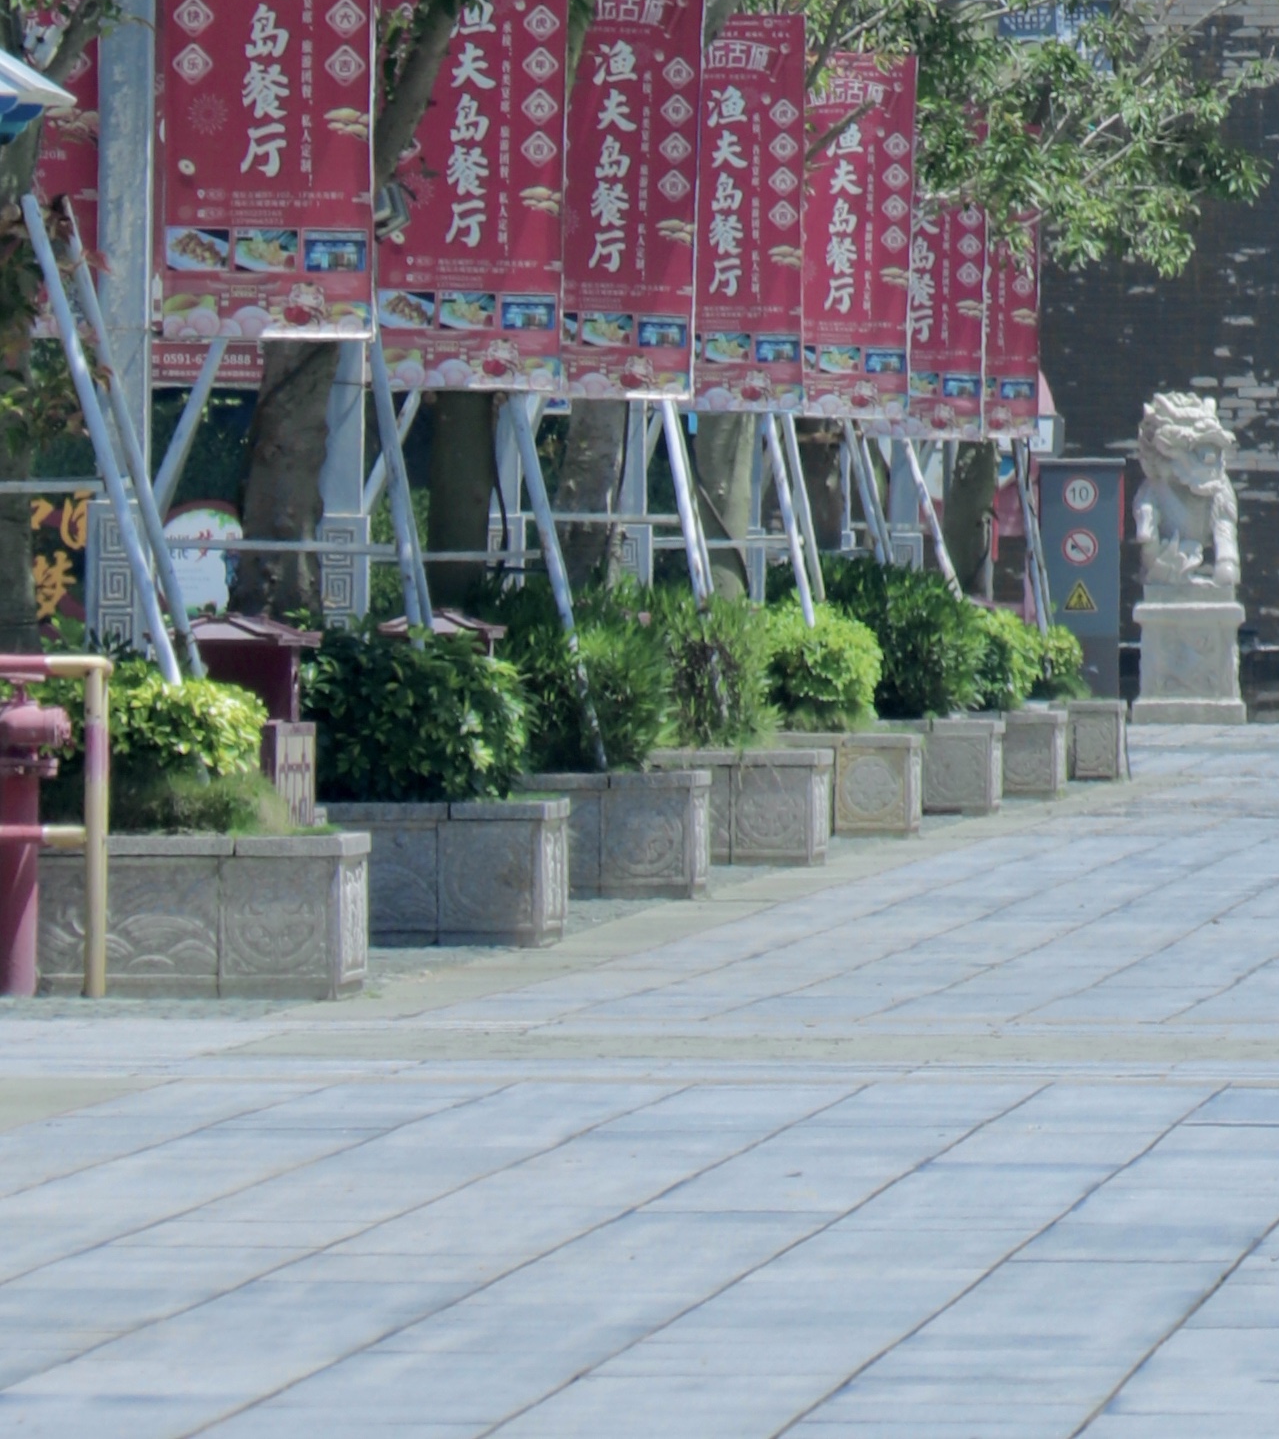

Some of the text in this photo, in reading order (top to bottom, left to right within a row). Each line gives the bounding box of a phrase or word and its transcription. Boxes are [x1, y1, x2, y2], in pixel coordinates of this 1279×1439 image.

[702, 41, 770, 74] 坛古城
[588, 39, 638, 273] 渔夫岛餐厅
[707, 85, 748, 297] 渔夫岛餐厅
[824, 122, 864, 314] 渔夫岛餐厅
[1069, 487, 1089, 502] 10
